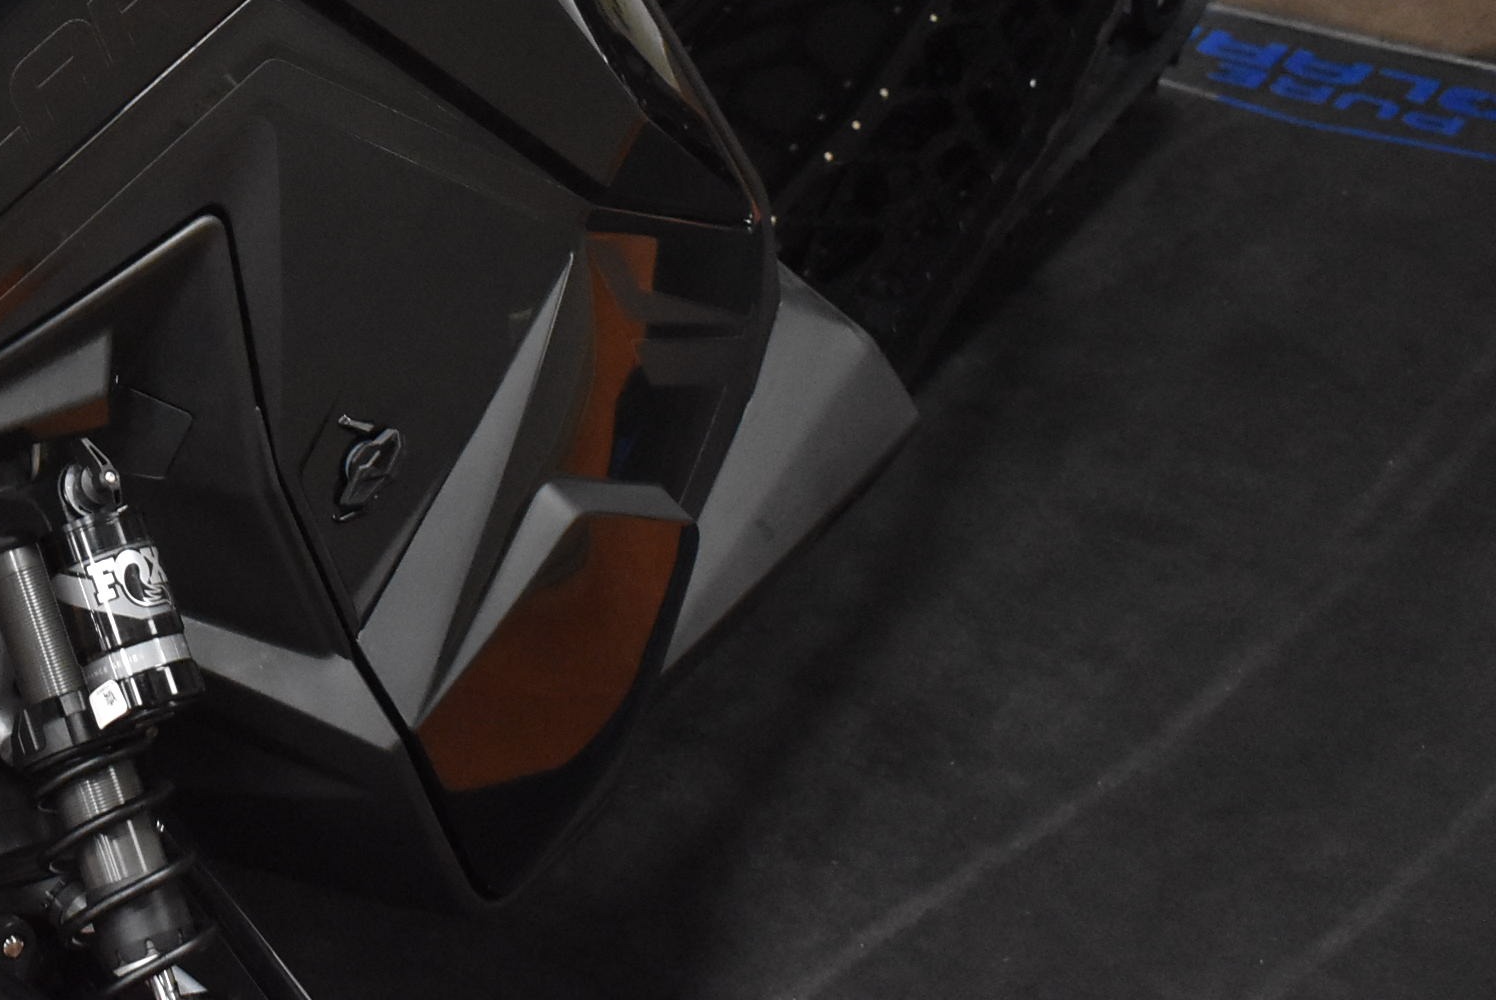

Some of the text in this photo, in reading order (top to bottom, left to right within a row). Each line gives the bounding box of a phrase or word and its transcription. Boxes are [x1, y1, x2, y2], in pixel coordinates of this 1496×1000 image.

[1189, 25, 1496, 121] OLAR
[1206, 61, 1466, 136] PURE
[86, 546, 172, 607] FOX
